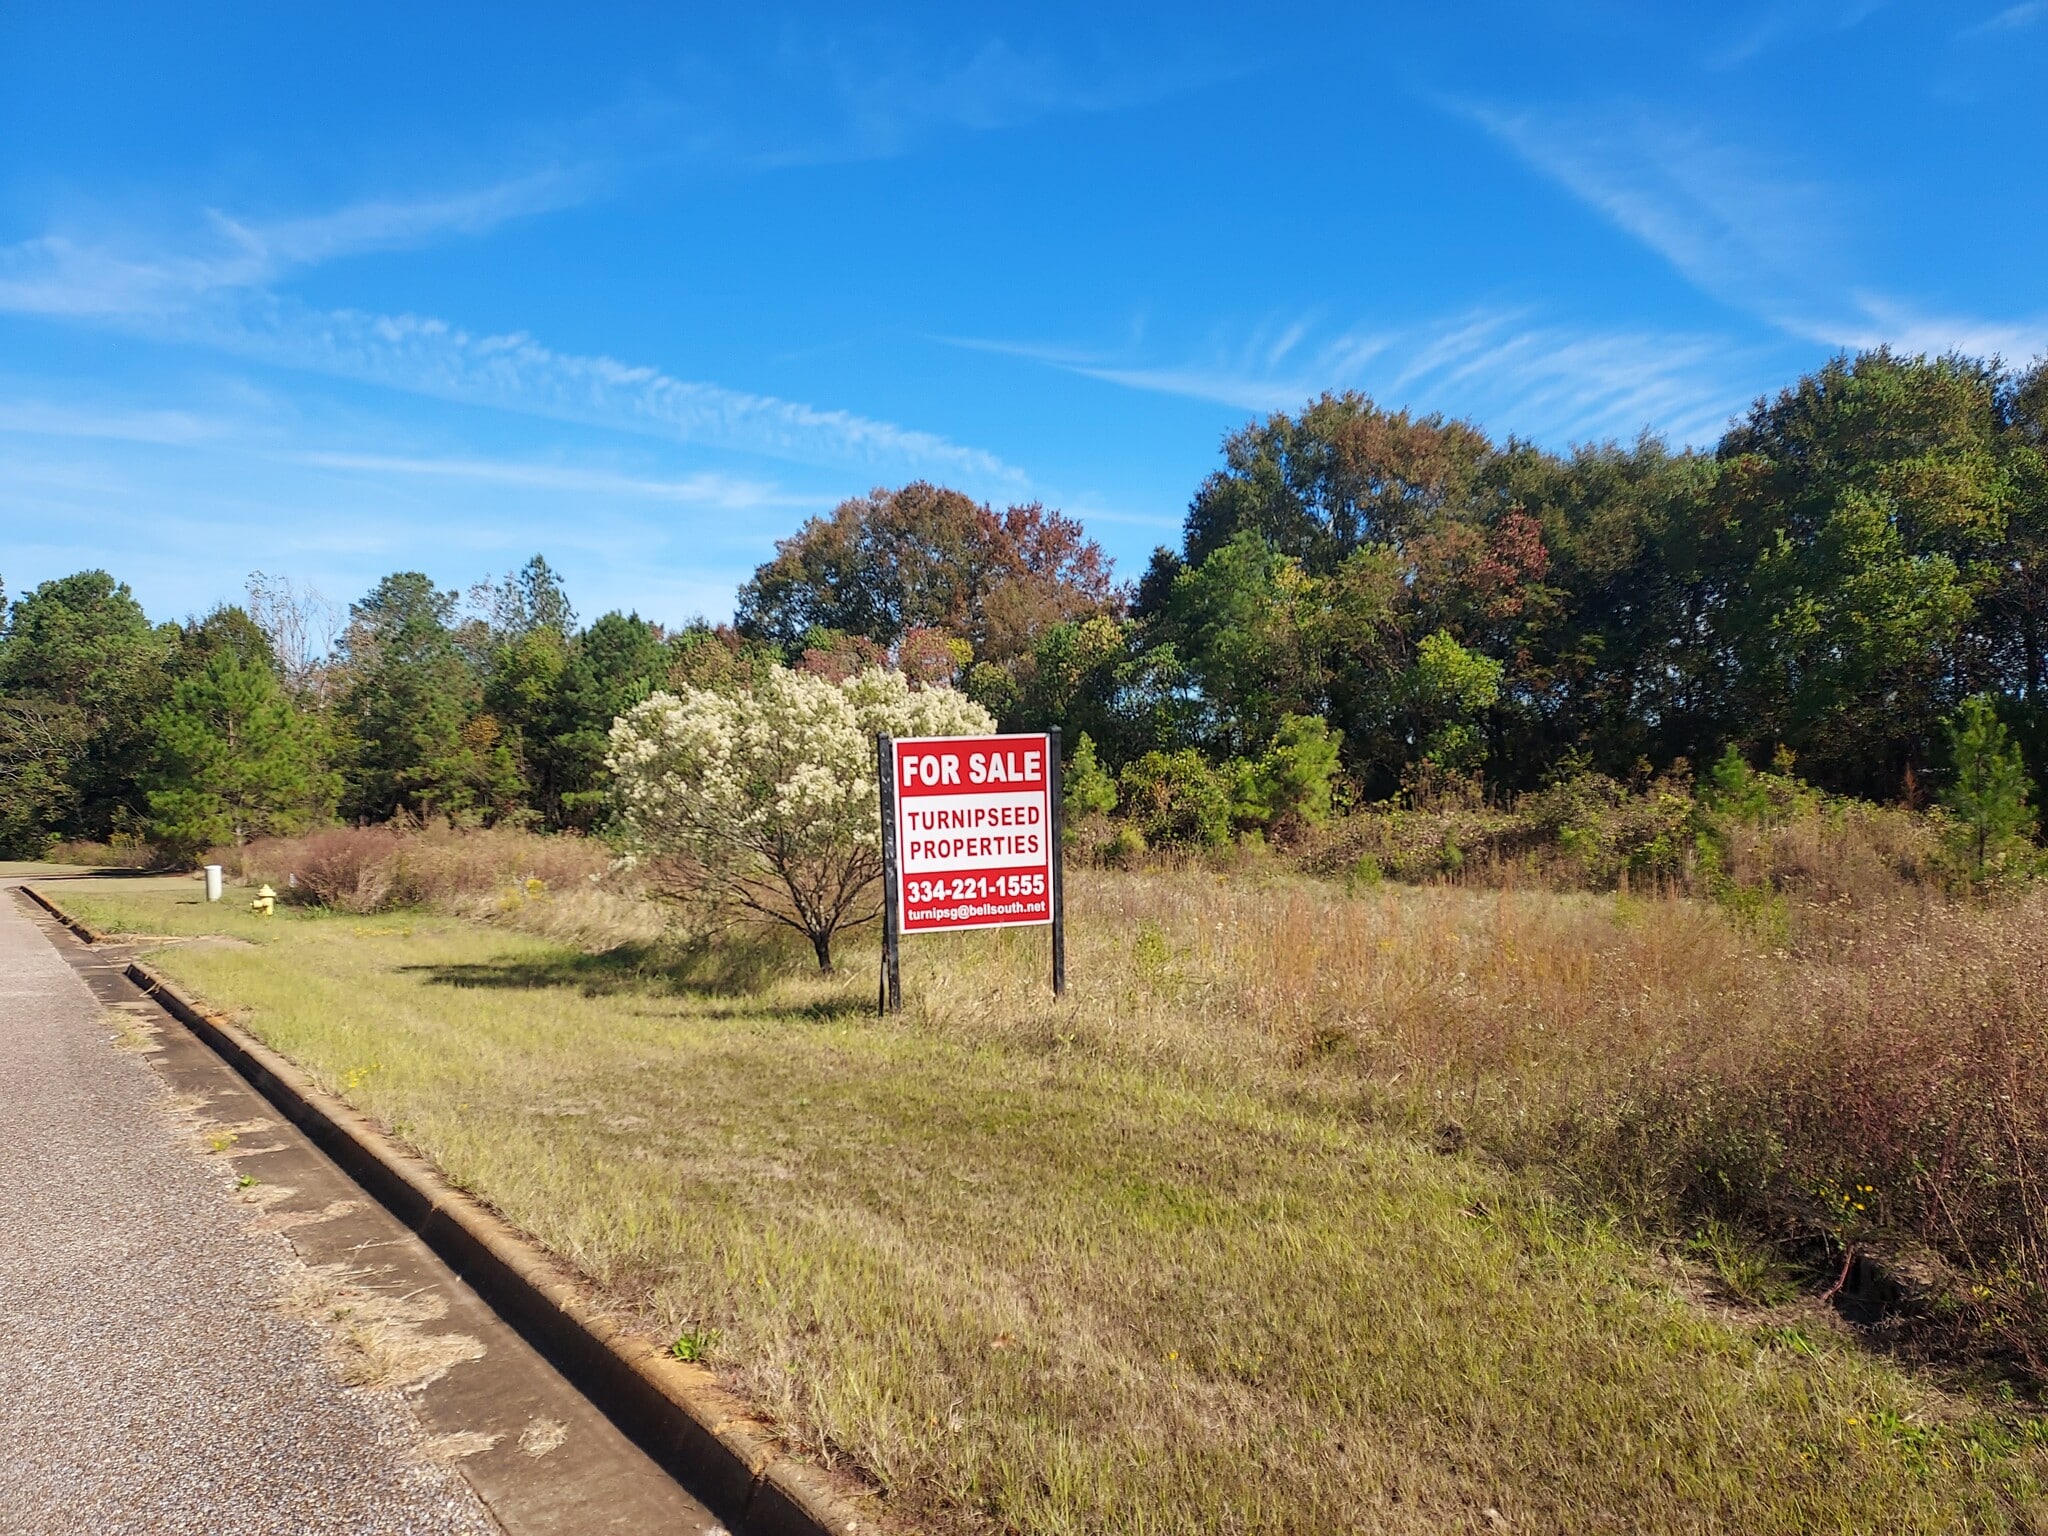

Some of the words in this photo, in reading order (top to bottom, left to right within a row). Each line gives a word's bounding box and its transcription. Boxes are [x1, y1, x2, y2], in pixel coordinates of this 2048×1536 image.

[902, 754, 961, 787] FOR
[969, 751, 1042, 784] SALE
[908, 806, 1040, 831] TURNIPSEED
[910, 834, 1039, 860] PROPERTIES
[907, 874, 1045, 903] 334-221-1555
[908, 901, 1045, 921] turnipsg@bellsouth.net
